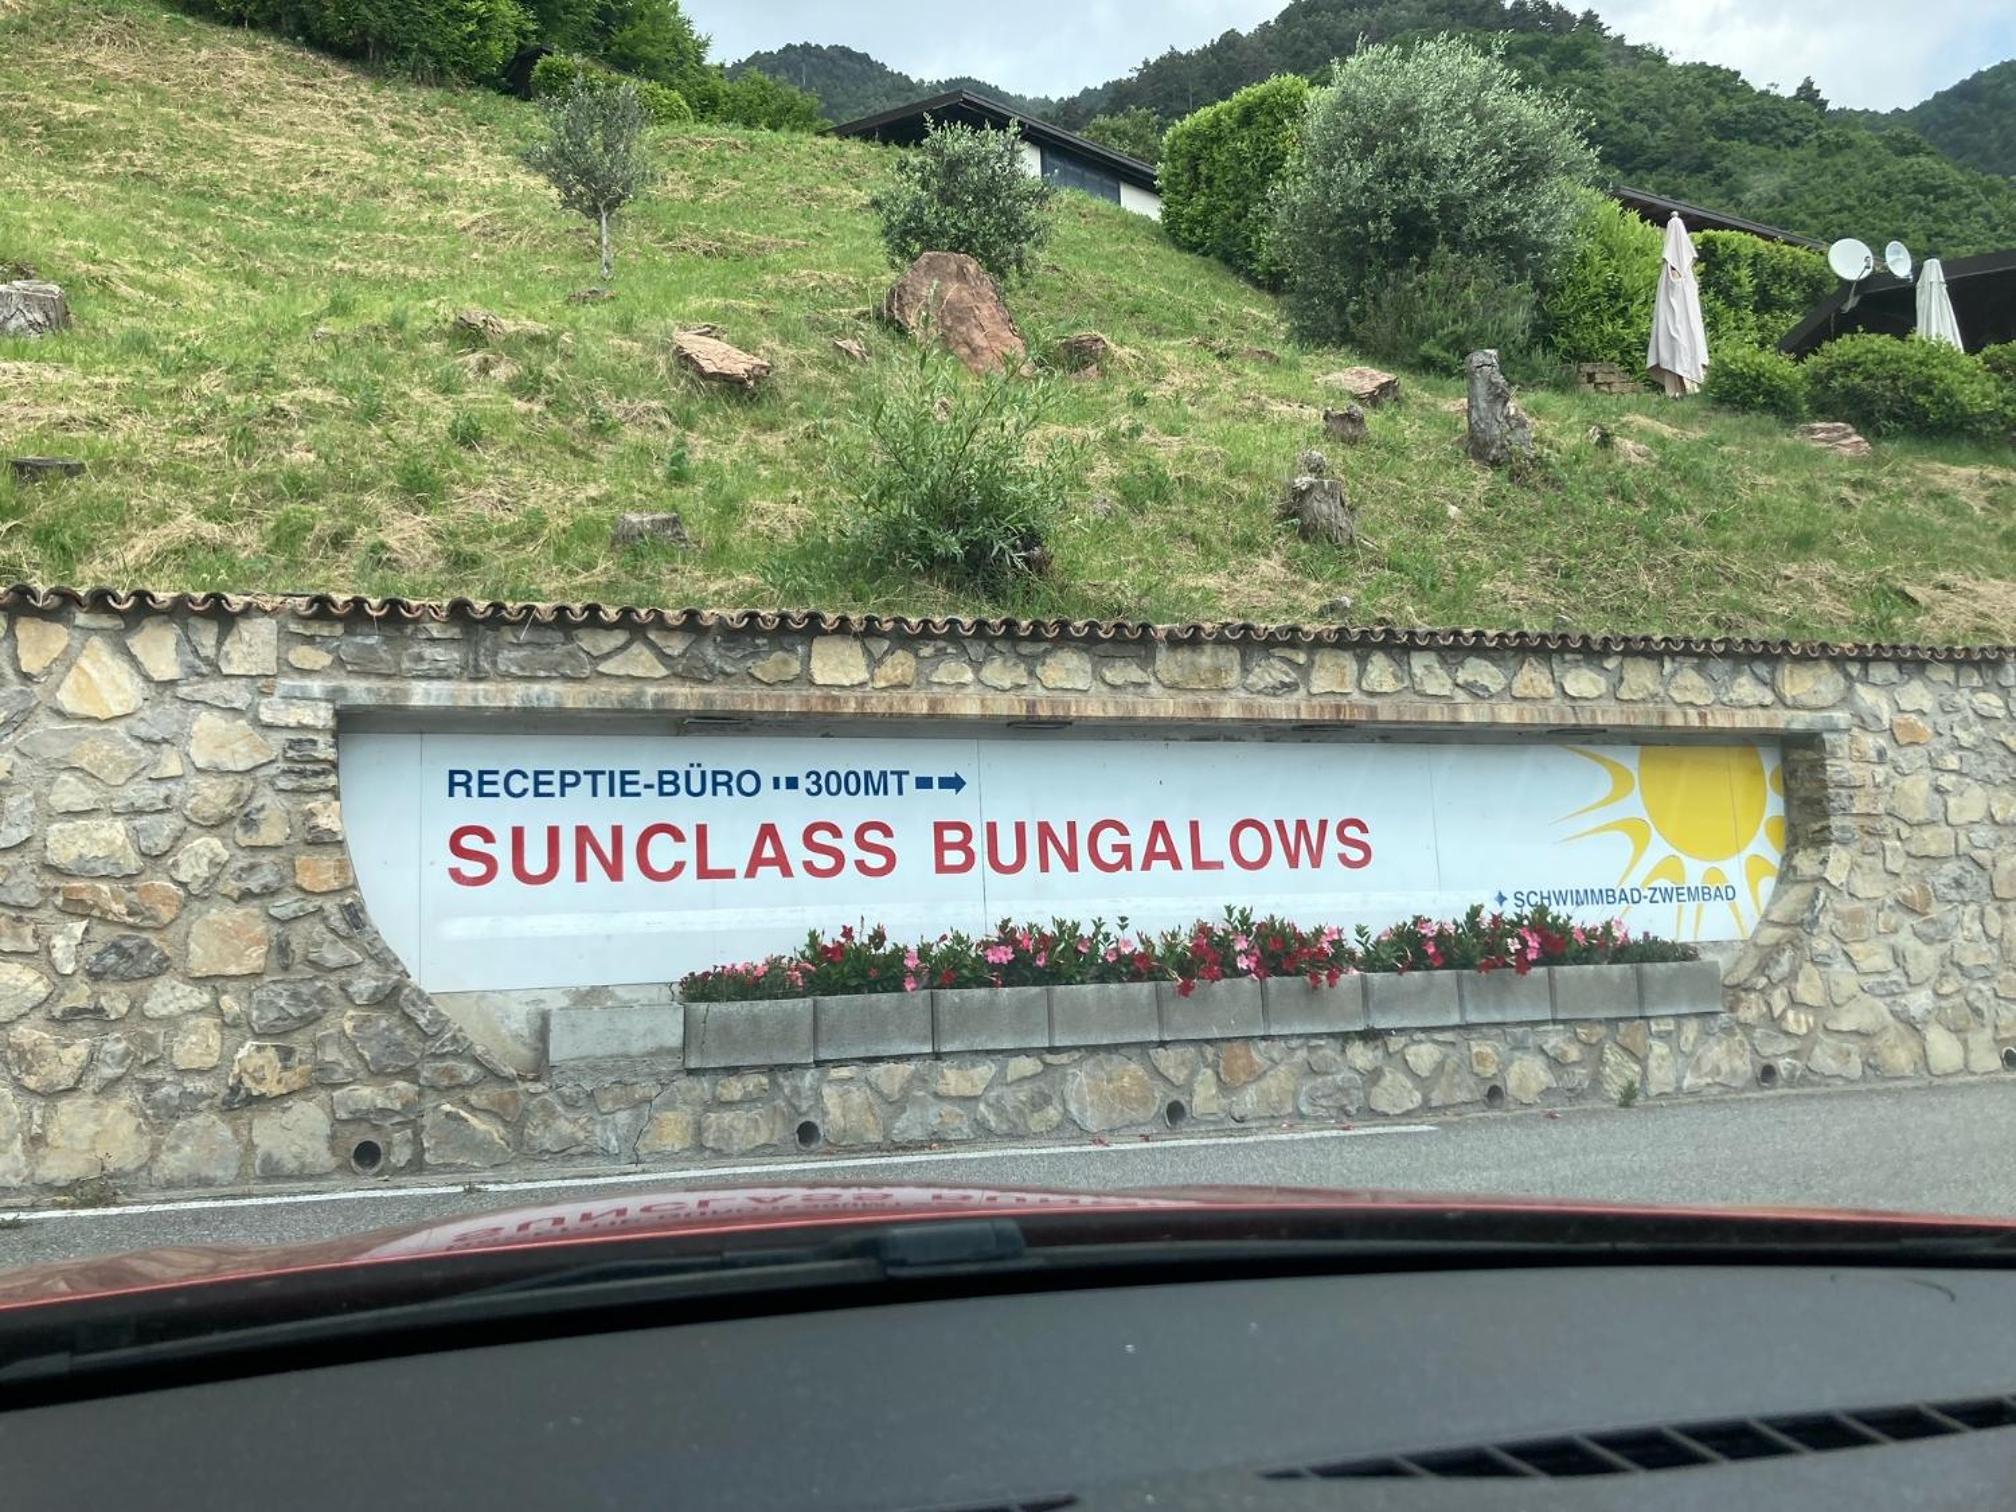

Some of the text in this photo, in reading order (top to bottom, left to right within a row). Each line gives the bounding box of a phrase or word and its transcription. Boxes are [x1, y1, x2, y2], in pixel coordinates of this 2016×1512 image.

[447, 762, 910, 799] RECEPTIE-BÜRO 300MT
[447, 817, 1373, 887] SUNCLASS BUNGALOWS
[1513, 884, 1737, 909] SCHWIMMBAD-ZWEMBAD
